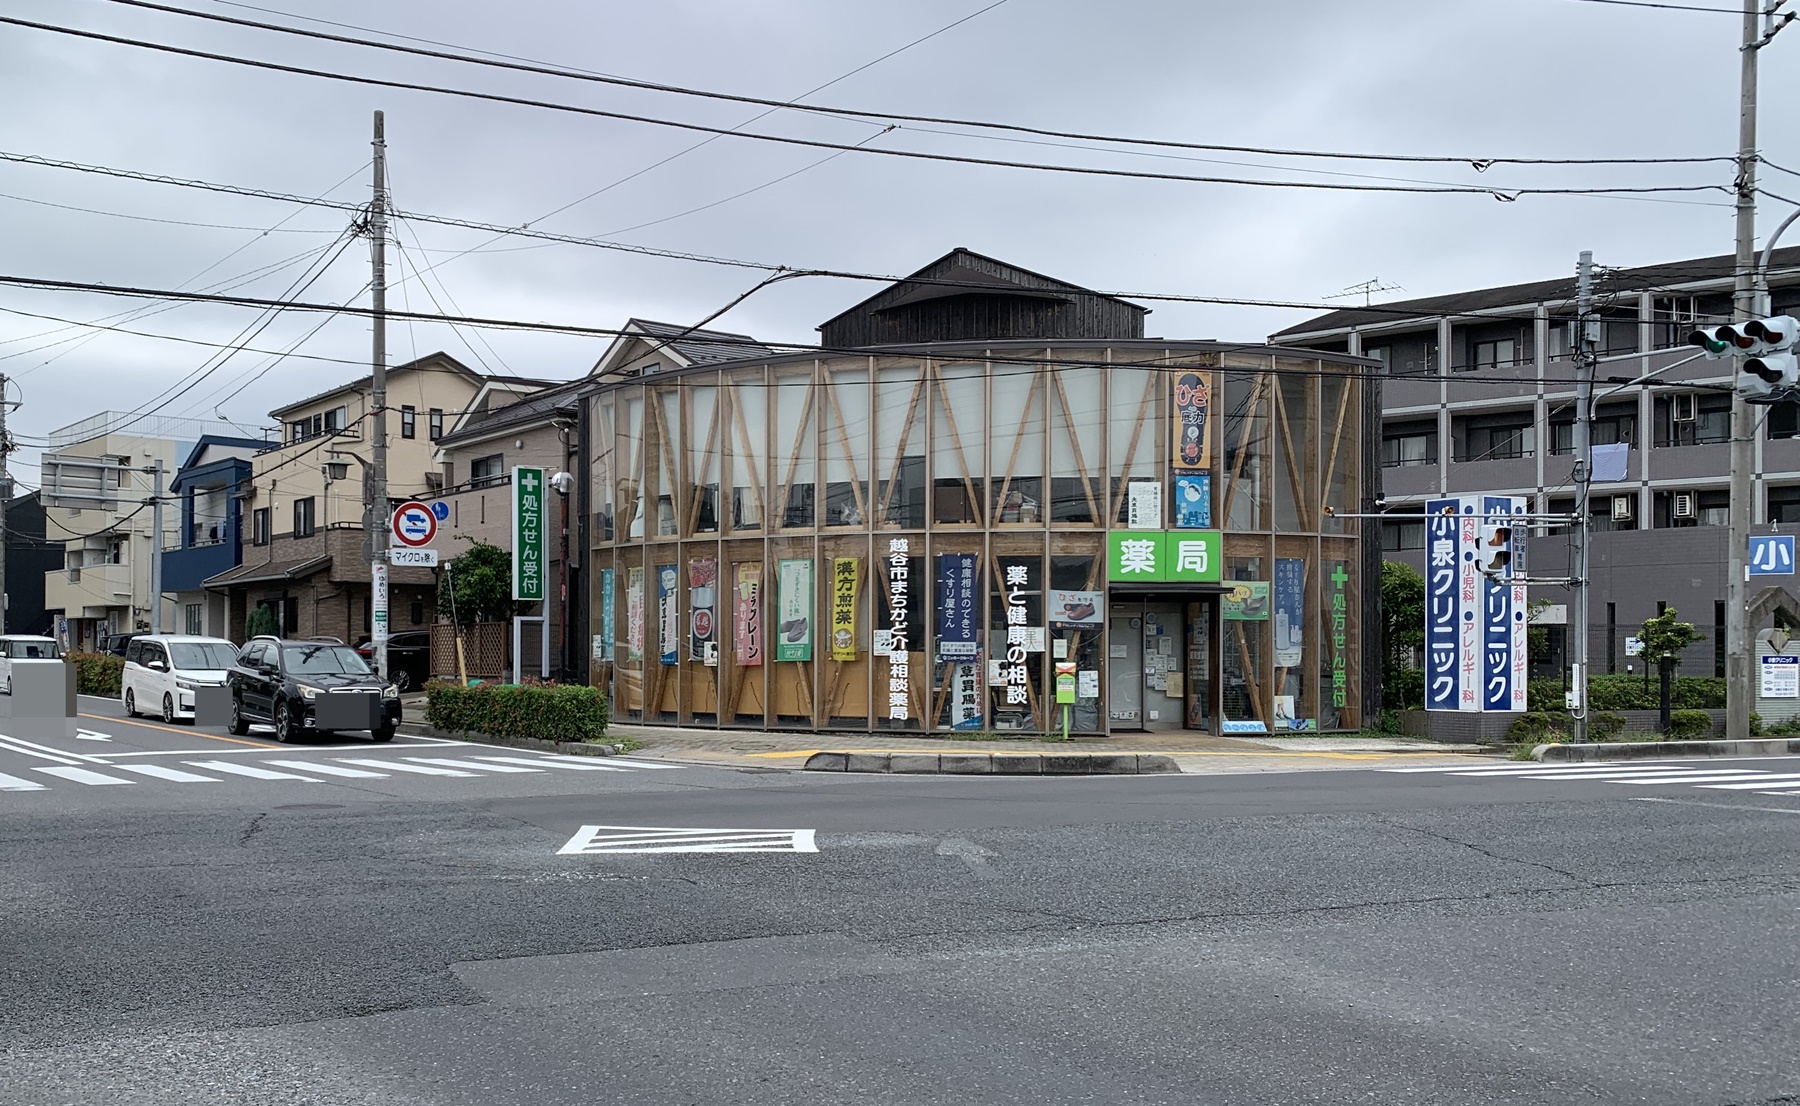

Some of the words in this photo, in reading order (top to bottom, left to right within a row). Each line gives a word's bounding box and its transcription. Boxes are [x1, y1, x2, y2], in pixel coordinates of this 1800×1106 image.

[1175, 384, 1210, 407] ひざ
[522, 495, 538, 593] 処方せん受付
[1120, 538, 1208, 574] 薬局
[1462, 516, 1475, 543] 内科
[1752, 540, 1790, 571] 小
[747, 583, 759, 659] ミラグレーン
[835, 561, 856, 625] 漢方煎薬
[945, 568, 956, 628] くすり屋さん
[960, 557, 971, 639] 健康相談のできる
[1431, 507, 1455, 702] 小泉クリニック
[1462, 563, 1475, 602] 小児科
[889, 538, 908, 721] 越谷市まちかど介護相談薬局
[1007, 565, 1028, 704] 薬と健康の相談
[1332, 594, 1346, 708] 処方せん受付
[1462, 622, 1475, 703] アレルギー科
[1513, 623, 1525, 703] アレルギー科
